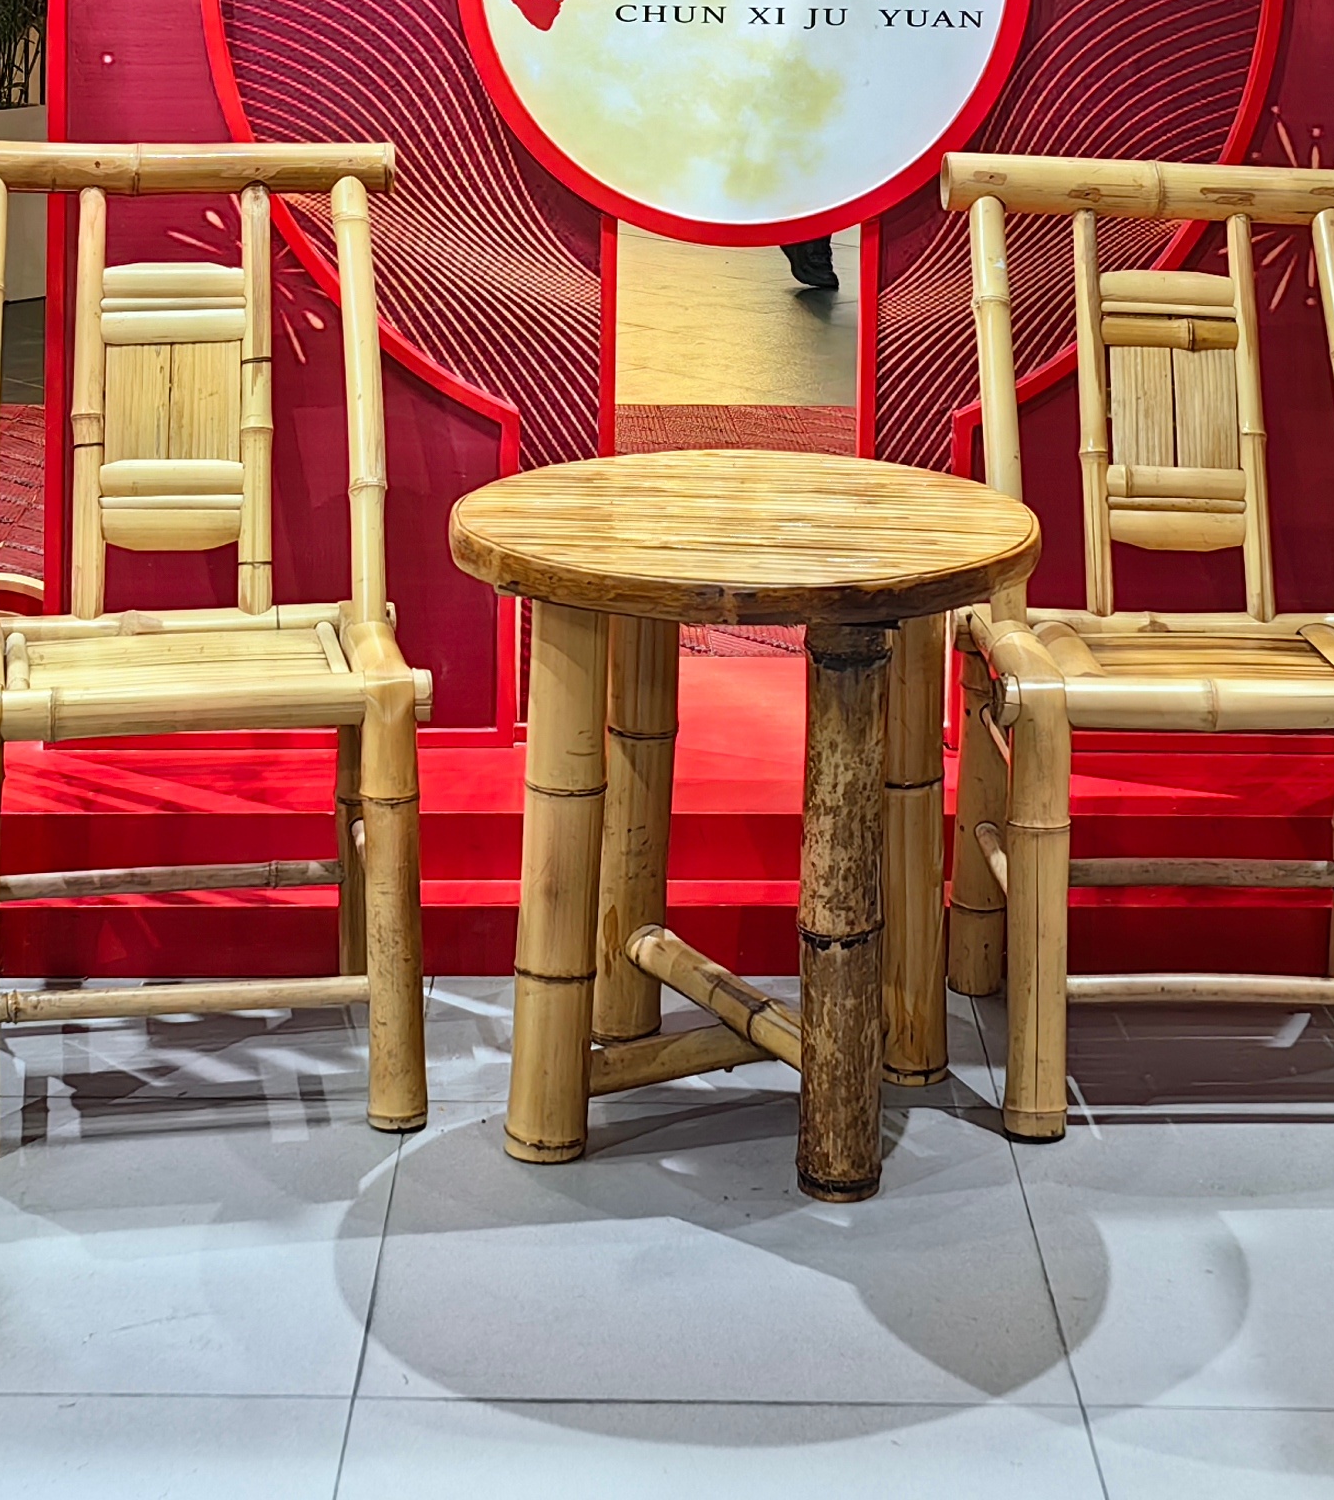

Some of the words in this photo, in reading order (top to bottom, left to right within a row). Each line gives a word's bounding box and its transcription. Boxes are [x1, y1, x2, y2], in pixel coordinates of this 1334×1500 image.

[615, 4, 726, 24] CHUN
[748, 6, 785, 25] XI
[803, 7, 848, 30] JU
[878, 8, 984, 29] YUAN
